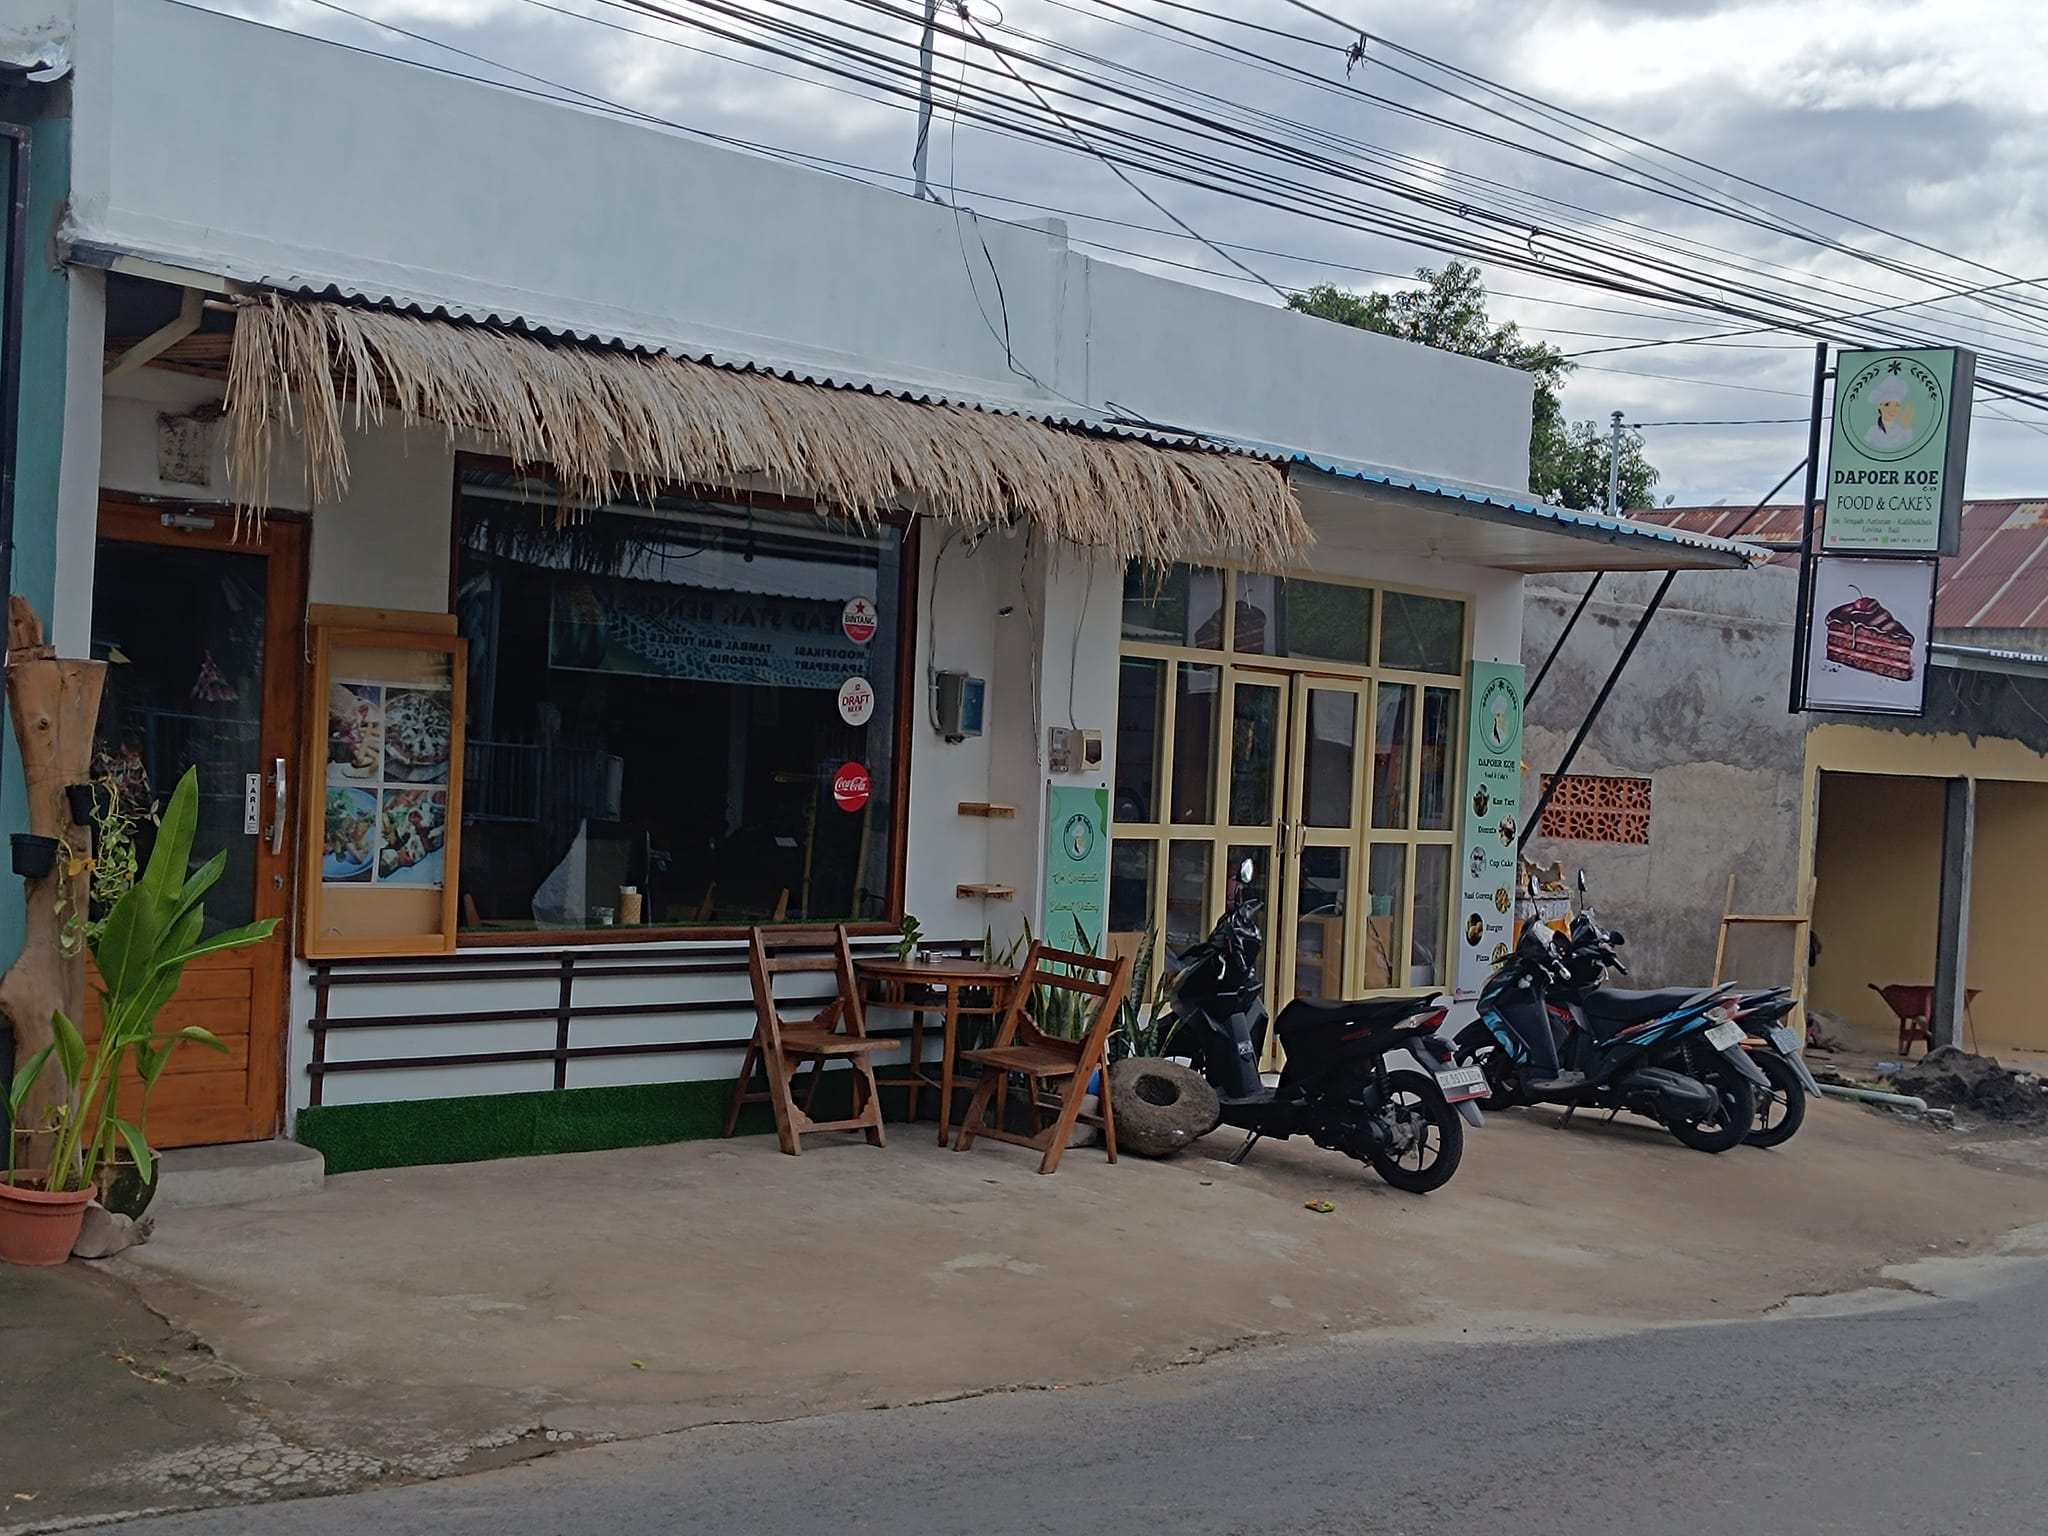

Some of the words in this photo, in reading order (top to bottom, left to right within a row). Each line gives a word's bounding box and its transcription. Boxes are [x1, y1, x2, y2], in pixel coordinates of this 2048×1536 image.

[1833, 470, 1900, 485] DAPOER
[1903, 470, 1939, 485] KOE
[1837, 495, 1873, 510] FOOD
[1876, 496, 1886, 511] &
[1888, 495, 1932, 511] CAKE'S
[844, 614, 875, 625] BINTANG
[842, 695, 870, 707] DRAFT
[249, 778, 257, 822] TARIK
[1486, 924, 1504, 933] Burger
[1475, 954, 1490, 962] Pizza
